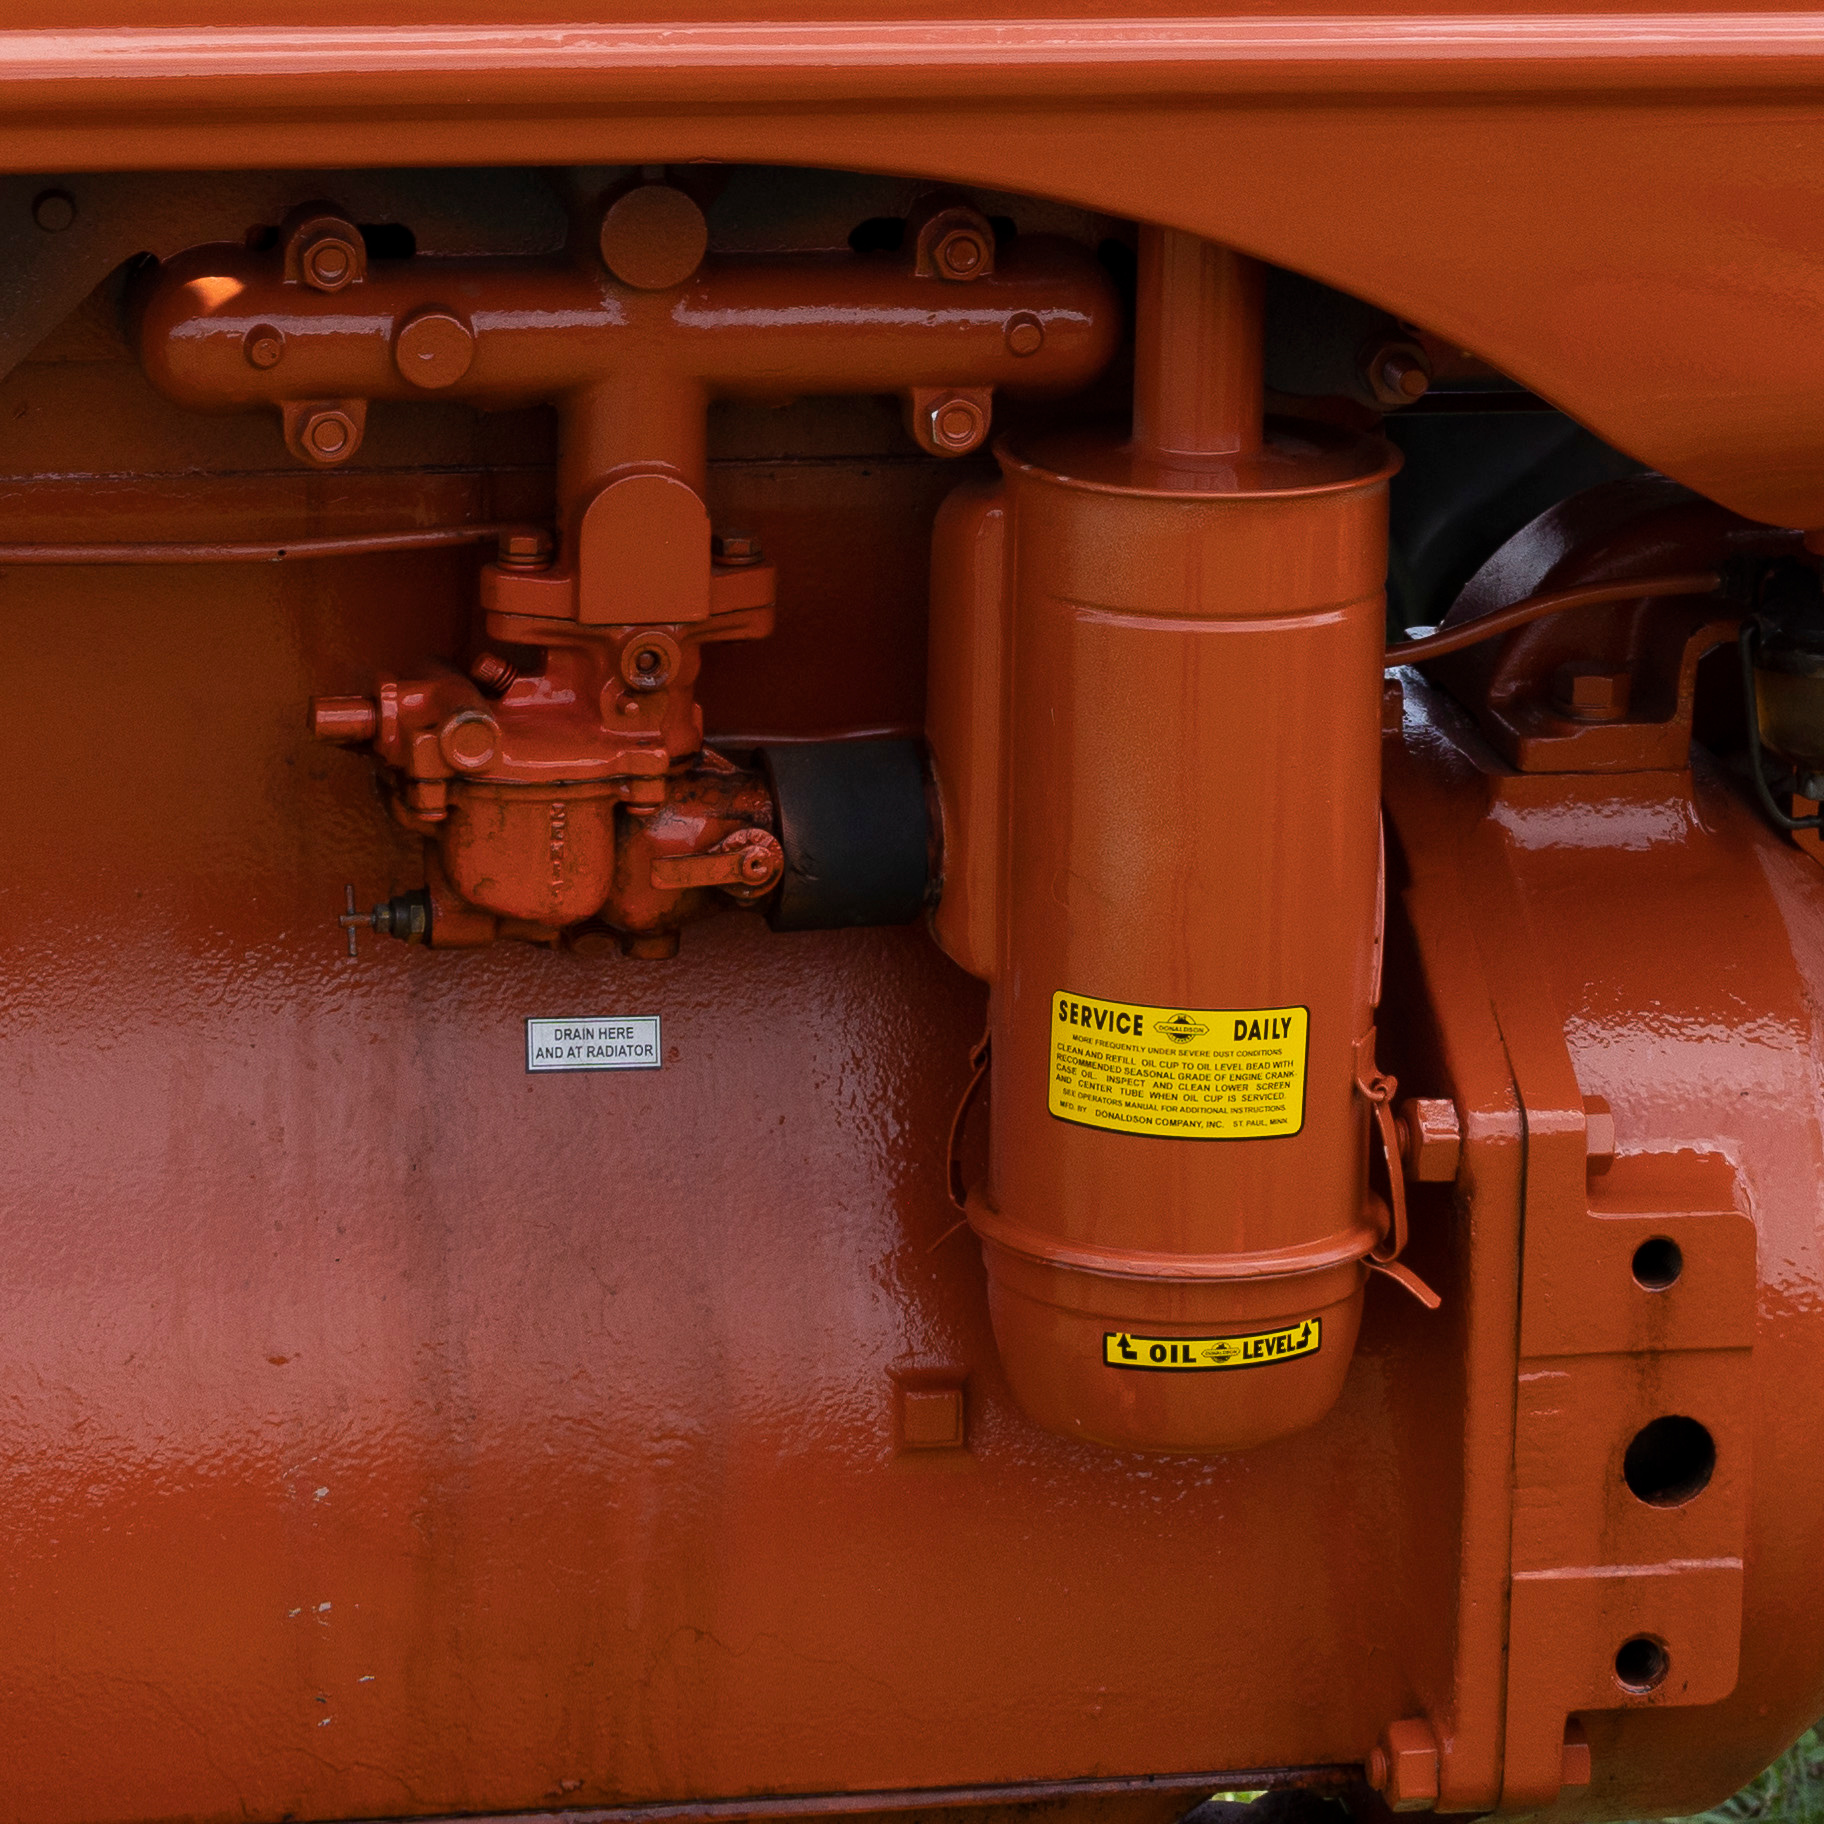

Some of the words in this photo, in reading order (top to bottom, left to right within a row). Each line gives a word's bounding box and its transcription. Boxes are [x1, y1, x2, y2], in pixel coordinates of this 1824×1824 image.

[1058, 999, 1143, 1037] SERVICE
[1233, 1017, 1292, 1042] DAILY
[554, 1028, 595, 1041] DRAIN
[598, 1027, 634, 1040] HERE
[1072, 1034, 1092, 1045] MORE
[1095, 1038, 1146, 1053] FREQUENTLY
[1148, 1044, 1176, 1056] UNDER
[1178, 1049, 1211, 1057] SEVERE
[1213, 1050, 1234, 1058] DUST
[1236, 1048, 1282, 1057] CONDITIONS
[536, 1047, 564, 1059] AND
[566, 1046, 583, 1058] AT
[586, 1044, 654, 1058] RADIATOR
[1057, 1042, 1083, 1055] CLEAN
[1085, 1049, 1104, 1060] AND
[1106, 1053, 1136, 1065] REFILL
[1142, 1059, 1156, 1068] OIL
[1159, 1059, 1179, 1069] CUP
[1182, 1062, 1194, 1070] TO
[1197, 1062, 1211, 1071] OIL
[1215, 1063, 1244, 1071] LEVEL
[1246, 1062, 1270, 1071] BEAD
[1273, 1060, 1294, 1069] WITH
[1056, 1063, 1077, 1075] CASE
[1106, 1075, 1145, 1087] INSPECT
[1153, 1081, 1173, 1090] AND
[1178, 1083, 1210, 1091] CLEAN
[1216, 1084, 1249, 1092] LOWER
[1256, 1081, 1291, 1091] SCREEN
[1057, 1053, 1122, 1074] RECOMMENDED
[1124, 1067, 1175, 1080] SEASONAL
[1178, 1072, 1211, 1081] GRADE
[1214, 1073, 1226, 1081] OF
[1230, 1072, 1263, 1081] ENGINE
[1056, 1073, 1072, 1084] AND
[1078, 1079, 1113, 1093] CENTER
[1120, 1087, 1144, 1098] TUBE
[1150, 1091, 1178, 1101] WHEN
[1183, 1094, 1198, 1102] OIL
[1204, 1094, 1223, 1103] CUP
[1228, 1094, 1236, 1103] IS
[1063, 1088, 1076, 1097] SEE
[1078, 1091, 1122, 1107] OPERATORS
[1125, 1101, 1158, 1111] MANUAL
[1161, 1105, 1179, 1113] FOR
[1180, 1106, 1228, 1114] ADDITIONAL
[1078, 1105, 1087, 1113] BY
[1095, 1109, 1153, 1125] DONALDSON
[1155, 1118, 1204, 1129] COMPANY,
[1206, 1120, 1224, 1128] INC.
[1149, 1343, 1197, 1364] OIL
[1242, 1334, 1297, 1360] LEVEL
